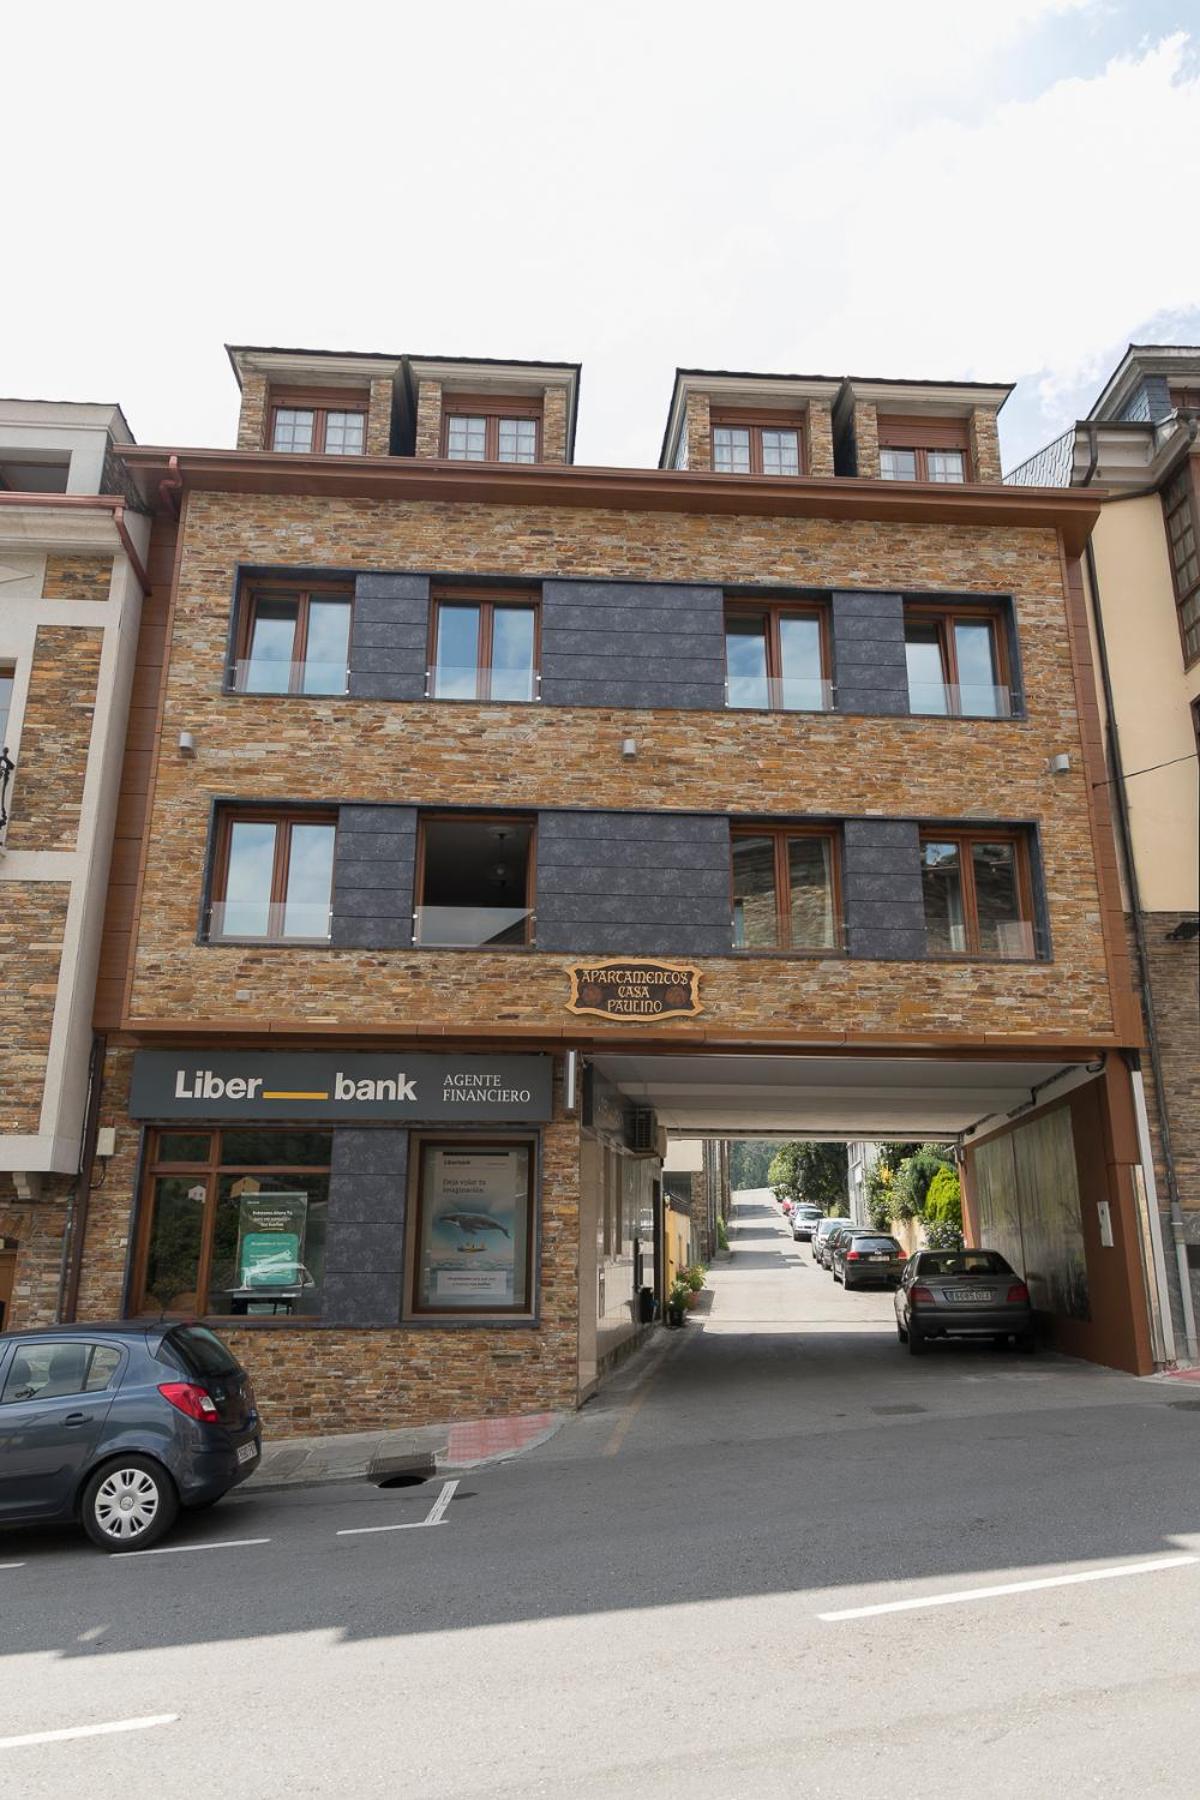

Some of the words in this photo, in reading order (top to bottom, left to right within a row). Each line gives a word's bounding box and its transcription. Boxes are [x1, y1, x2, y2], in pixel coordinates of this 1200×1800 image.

[581, 970, 689, 985] APARTAMENTOS
[618, 986, 650, 998] CASA
[607, 1000, 663, 1013] PAULINO
[175, 1070, 263, 1099] Liber
[334, 1072, 418, 1100] bank
[443, 1074, 502, 1087] AGENTE
[443, 1089, 531, 1103] FINANCIERO
